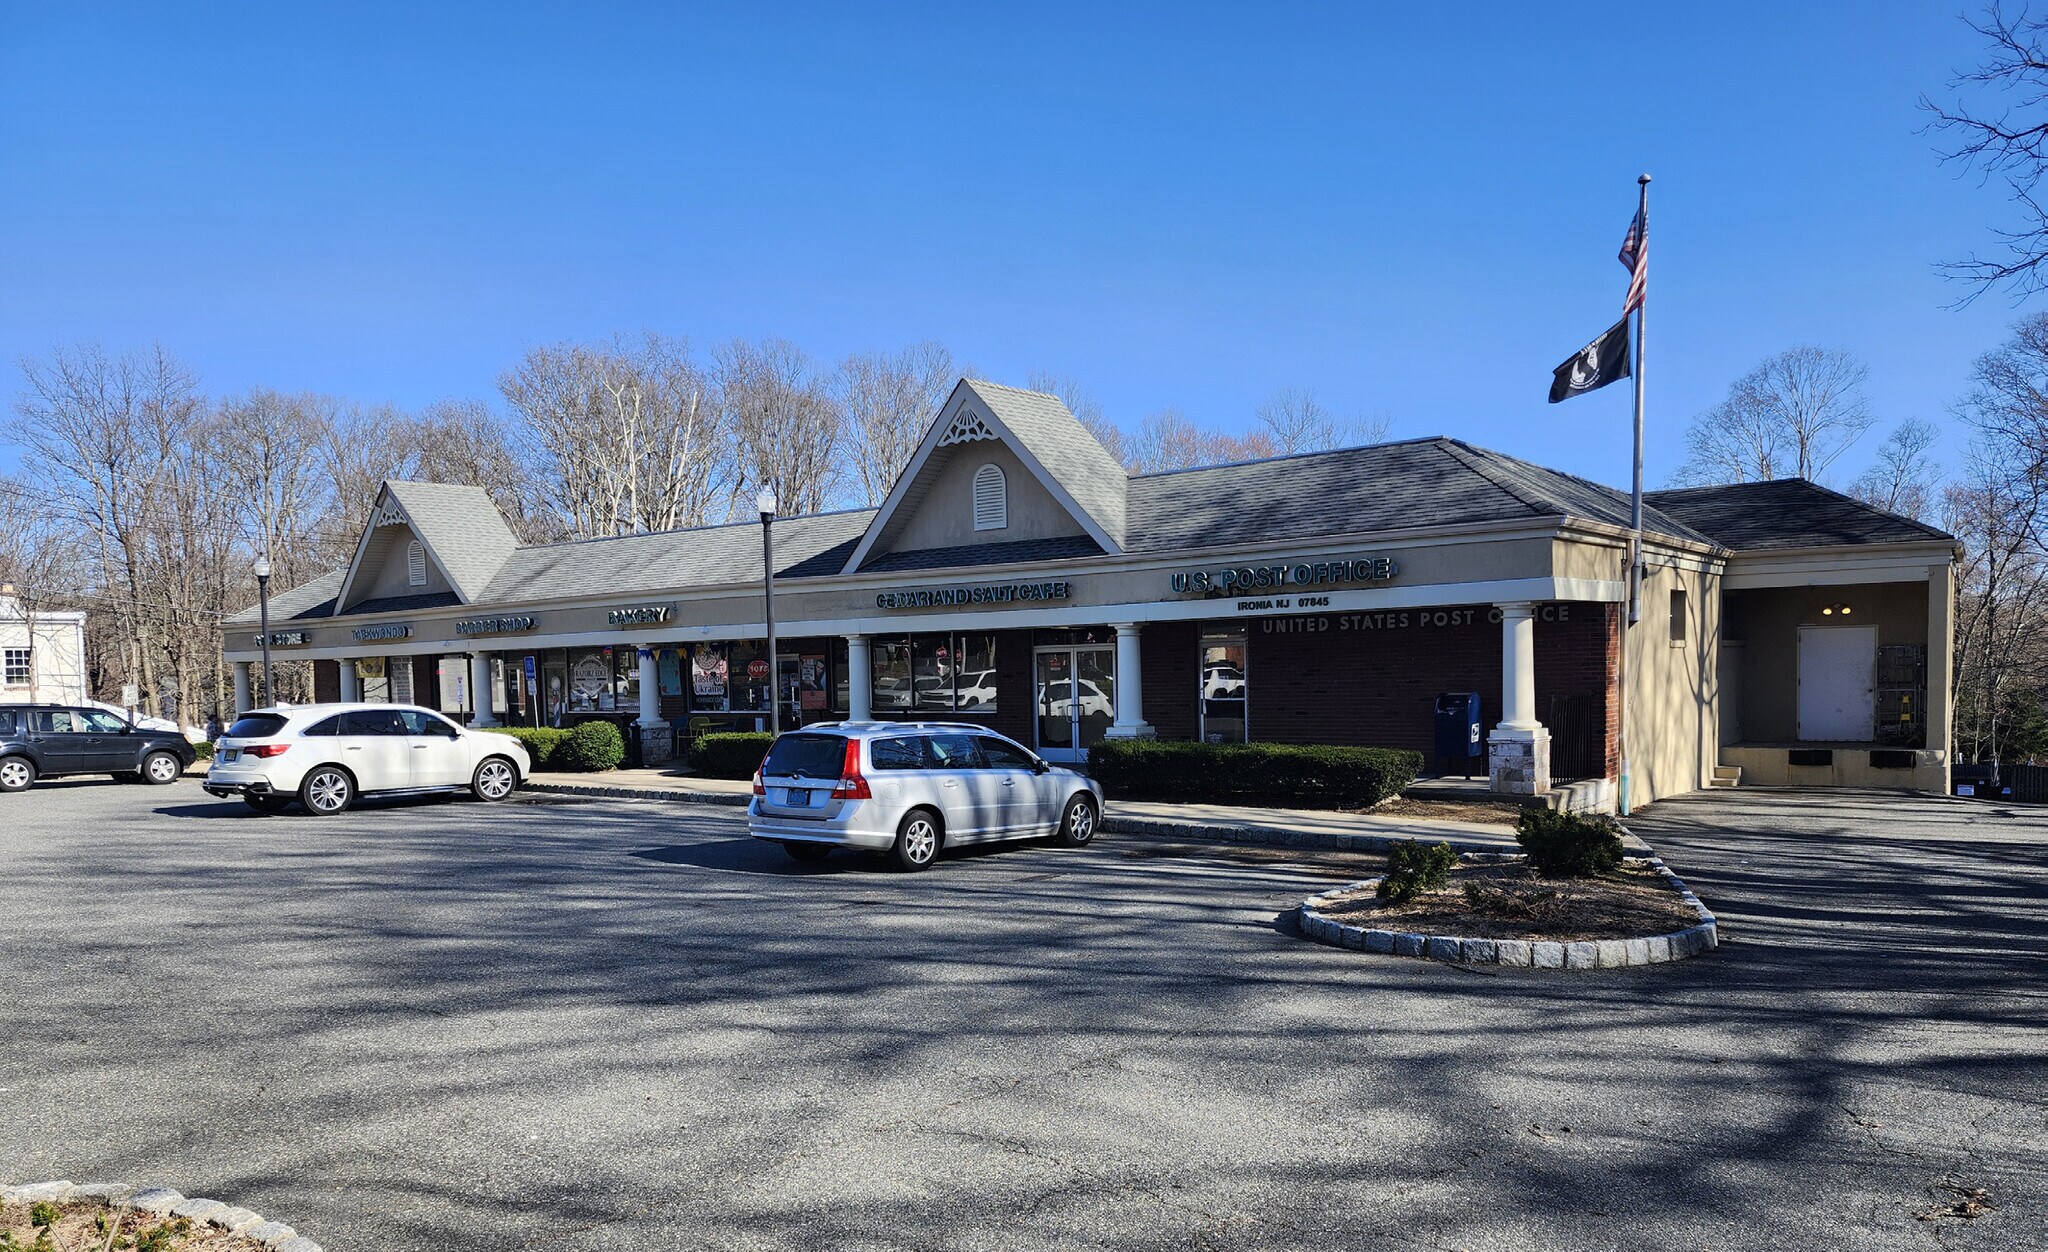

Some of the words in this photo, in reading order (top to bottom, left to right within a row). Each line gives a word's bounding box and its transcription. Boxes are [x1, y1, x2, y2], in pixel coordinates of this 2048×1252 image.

[1170, 571, 1215, 594] U.S.
[1221, 565, 1288, 590] POST
[1293, 557, 1390, 586] OFFICE
[875, 590, 930, 609] CEDAR
[933, 587, 969, 606] AND
[972, 585, 1014, 604] SALT
[1018, 581, 1066, 601] CAFE
[1237, 600, 1273, 611] IRONIA
[1276, 599, 1290, 609] NJ
[1298, 596, 1329, 608] 07845
[608, 607, 668, 625] BAKERY
[1262, 616, 1329, 634] UNITED
[1339, 611, 1410, 631] STATES
[1419, 610, 1475, 627] POST
[1487, 605, 1569, 625] OICE
[351, 625, 406, 641] TAEKWONDO
[455, 619, 498, 634] BARBER
[499, 617, 531, 632] SHOP
[694, 674, 714, 684] Taste
[694, 684, 725, 694] Ukraine
